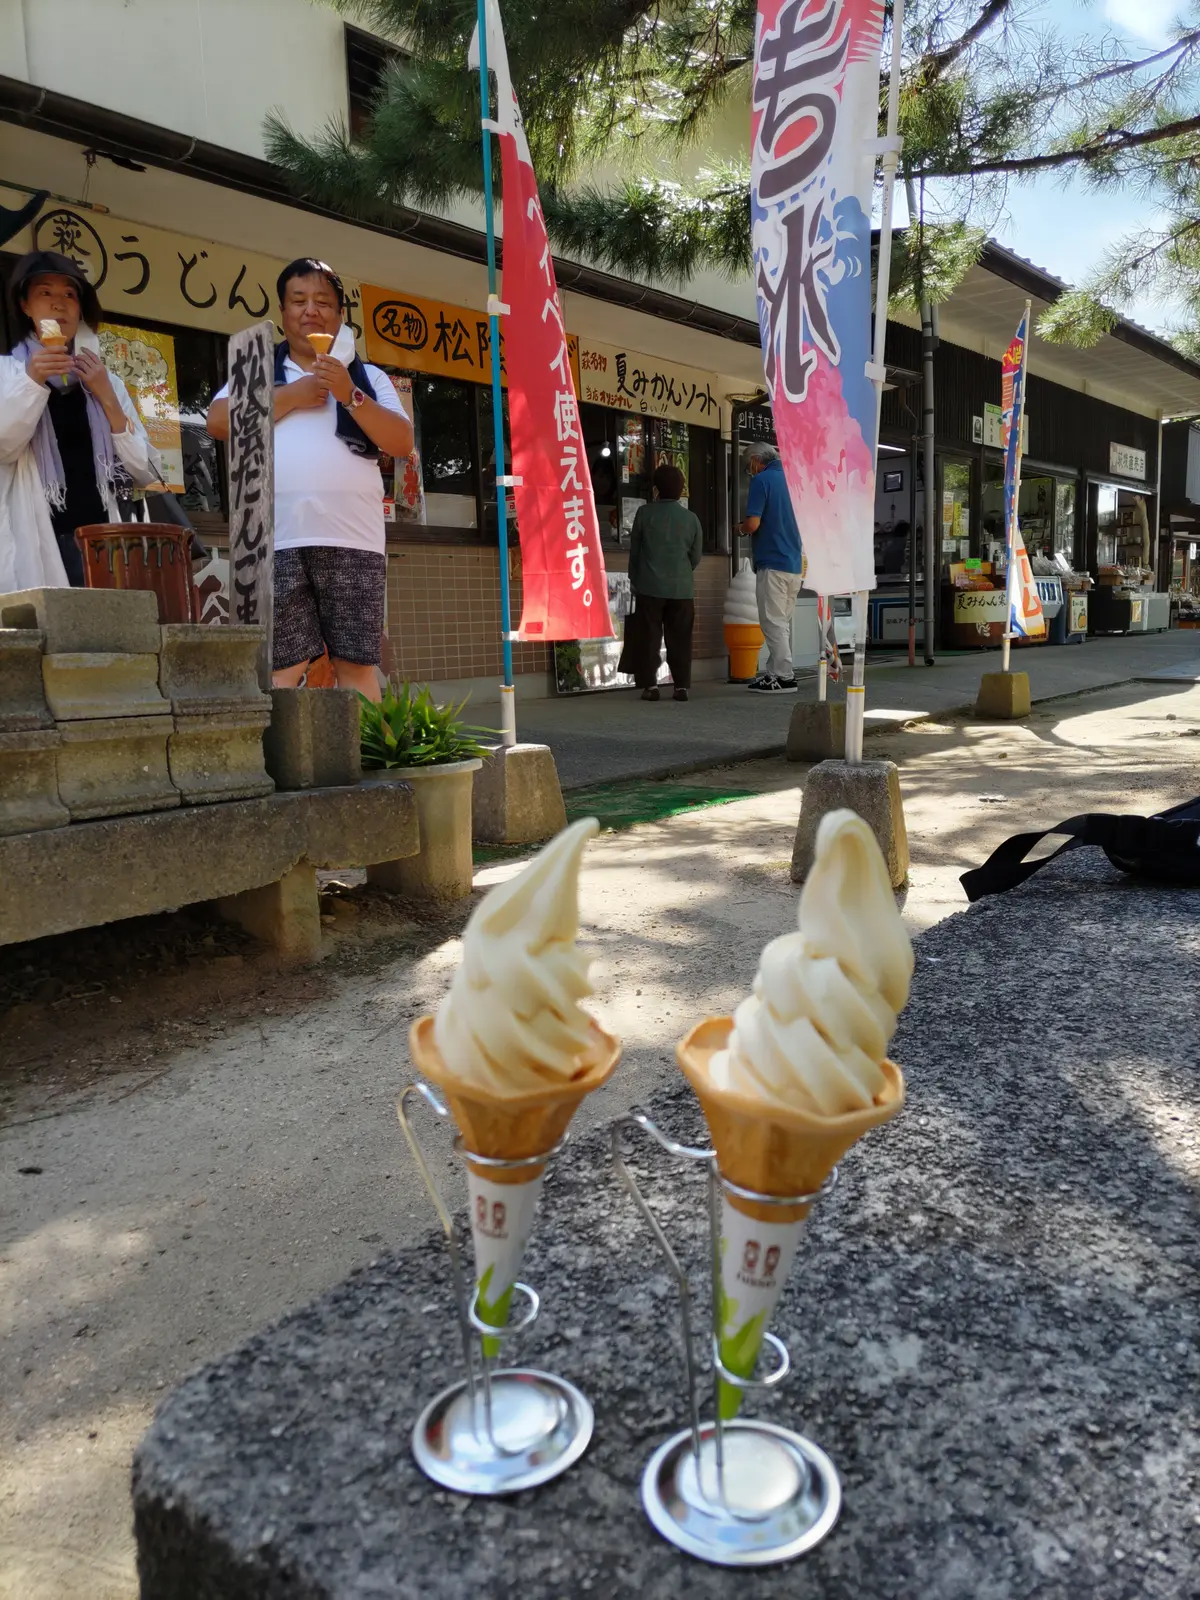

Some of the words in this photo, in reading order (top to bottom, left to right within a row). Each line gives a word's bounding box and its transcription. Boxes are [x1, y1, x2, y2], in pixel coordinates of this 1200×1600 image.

[381, 308, 423, 344] 名物
[581, 350, 608, 373] 萩名物
[615, 352, 717, 416] 夏みかんソフト
